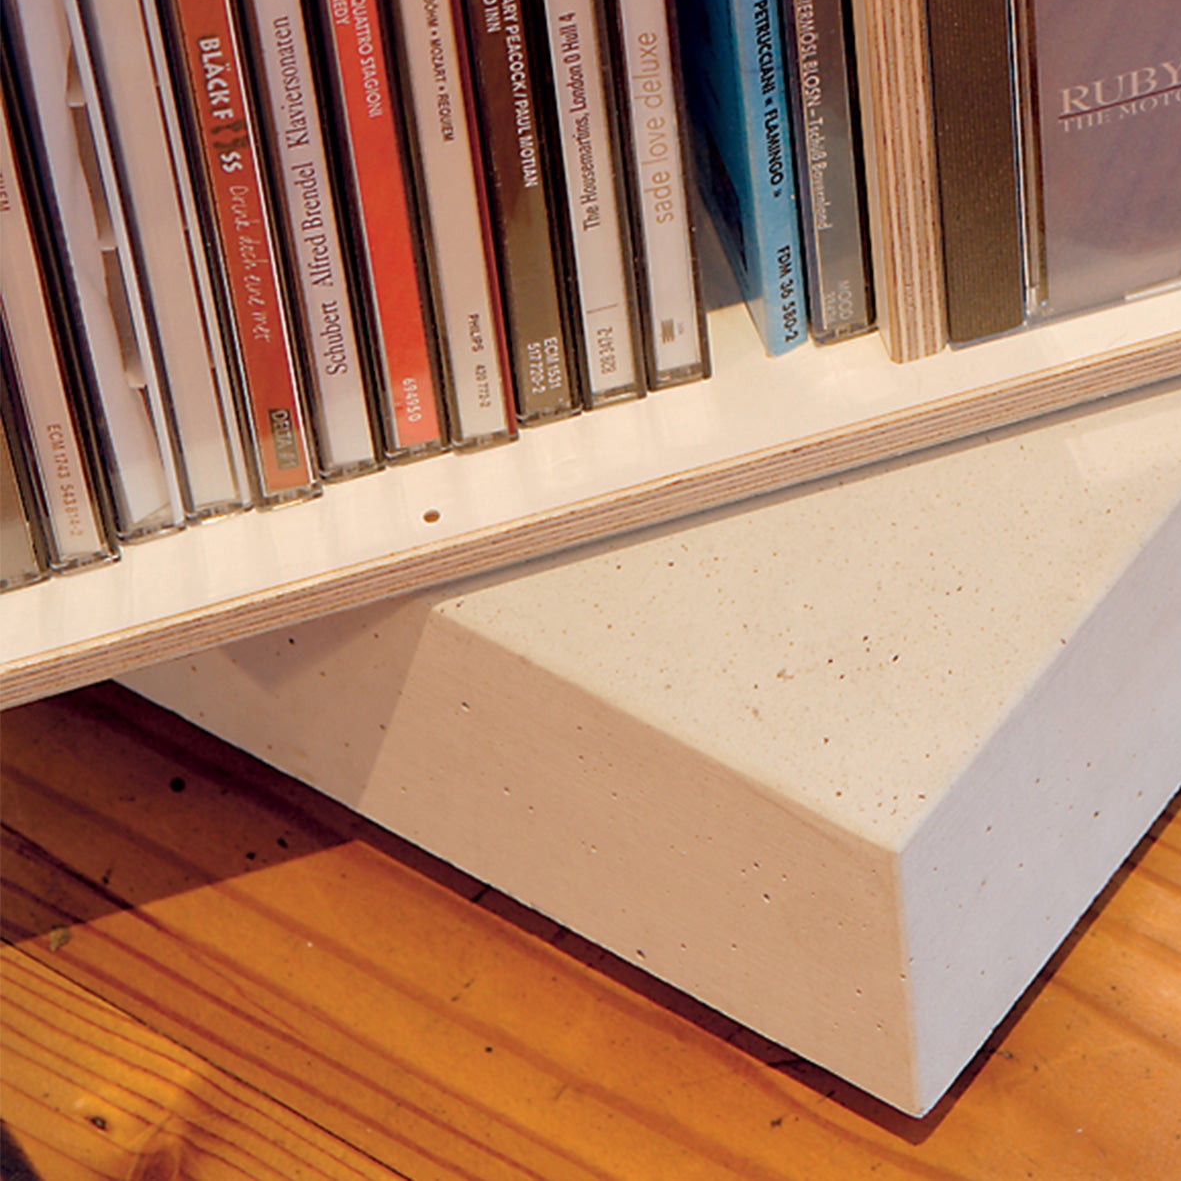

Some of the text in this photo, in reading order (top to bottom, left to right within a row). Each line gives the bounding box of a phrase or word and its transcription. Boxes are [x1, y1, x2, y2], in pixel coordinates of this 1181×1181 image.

[484, 6, 501, 32] INN
[559, 23, 579, 52] Hull
[199, 37, 230, 104] BLÄCK
[429, 37, 446, 82] MOZART
[505, 24, 526, 91] PEACOCK
[754, 0, 775, 94] PETRUCCIANI
[359, 56, 382, 117] STAGIONI
[566, 63, 587, 111] London
[800, 60, 820, 107] BLOSN
[437, 93, 454, 141] REQUIEM
[514, 98, 531, 134] PAUL
[631, 32, 674, 223] sade love deluxe
[1059, 111, 1111, 132] THE
[519, 135, 538, 187] MOTIAN
[572, 112, 597, 204] Housemartins,
[764, 109, 783, 185] FLAMINGO
[273, 16, 347, 375] Schubert Alfred Brendel Klaviersonaten
[582, 205, 600, 231] The
[776, 244, 798, 342] FDM 36 580-2
[837, 279, 853, 320] MOOD
[468, 313, 484, 352] PHILIPS
[526, 342, 546, 393] 517 720-2
[543, 337, 562, 389] ECM 1531
[45, 423, 65, 450] ECM
[270, 408, 297, 449] DELTA
[53, 452, 71, 479] 1743
[59, 483, 77, 505] 543
